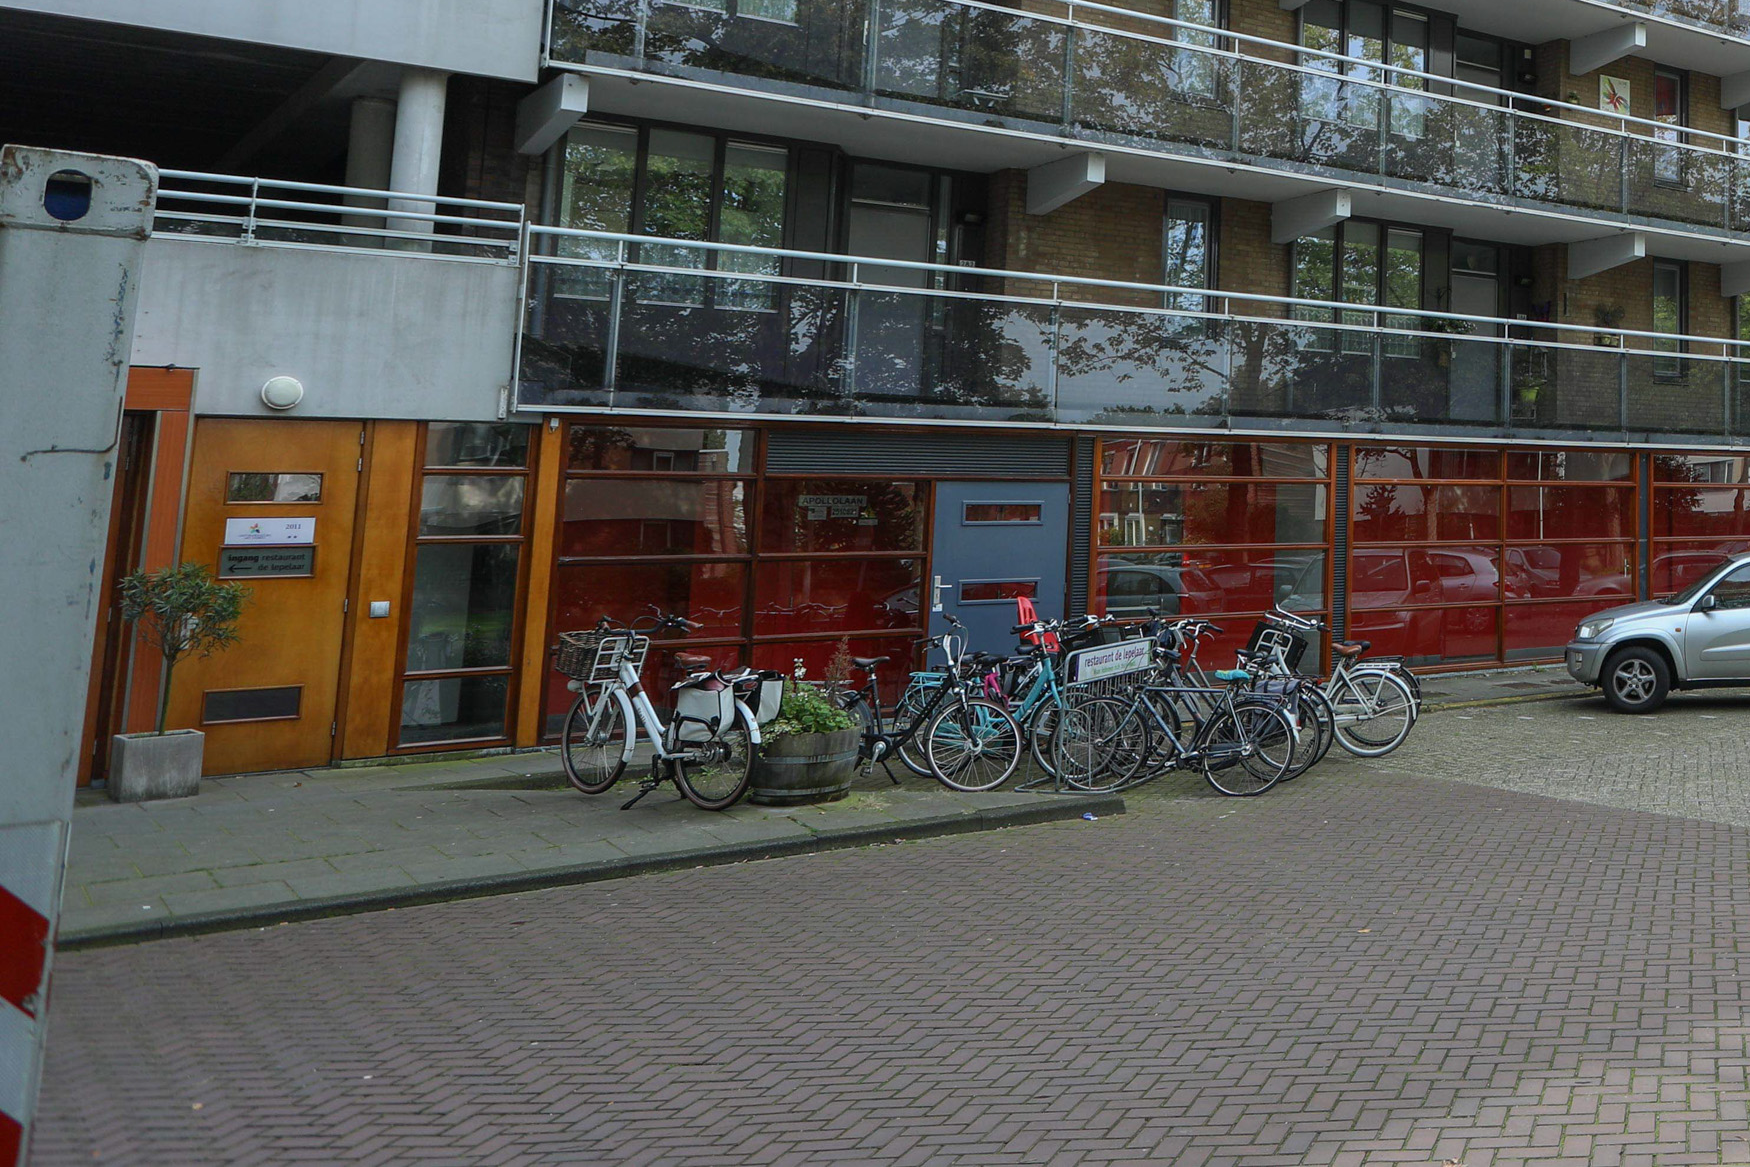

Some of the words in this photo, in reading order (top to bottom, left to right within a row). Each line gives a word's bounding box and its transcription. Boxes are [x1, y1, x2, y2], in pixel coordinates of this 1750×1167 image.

[802, 497, 864, 505] APOLLOLAAN
[228, 554, 260, 564] ingang
[262, 553, 306, 562] restaurant
[257, 564, 270, 572] de
[271, 563, 305, 573] lepelaar
[1084, 652, 1114, 668] restaurant
[1115, 649, 1122, 662] de
[1123, 646, 1145, 661] lepelaar
